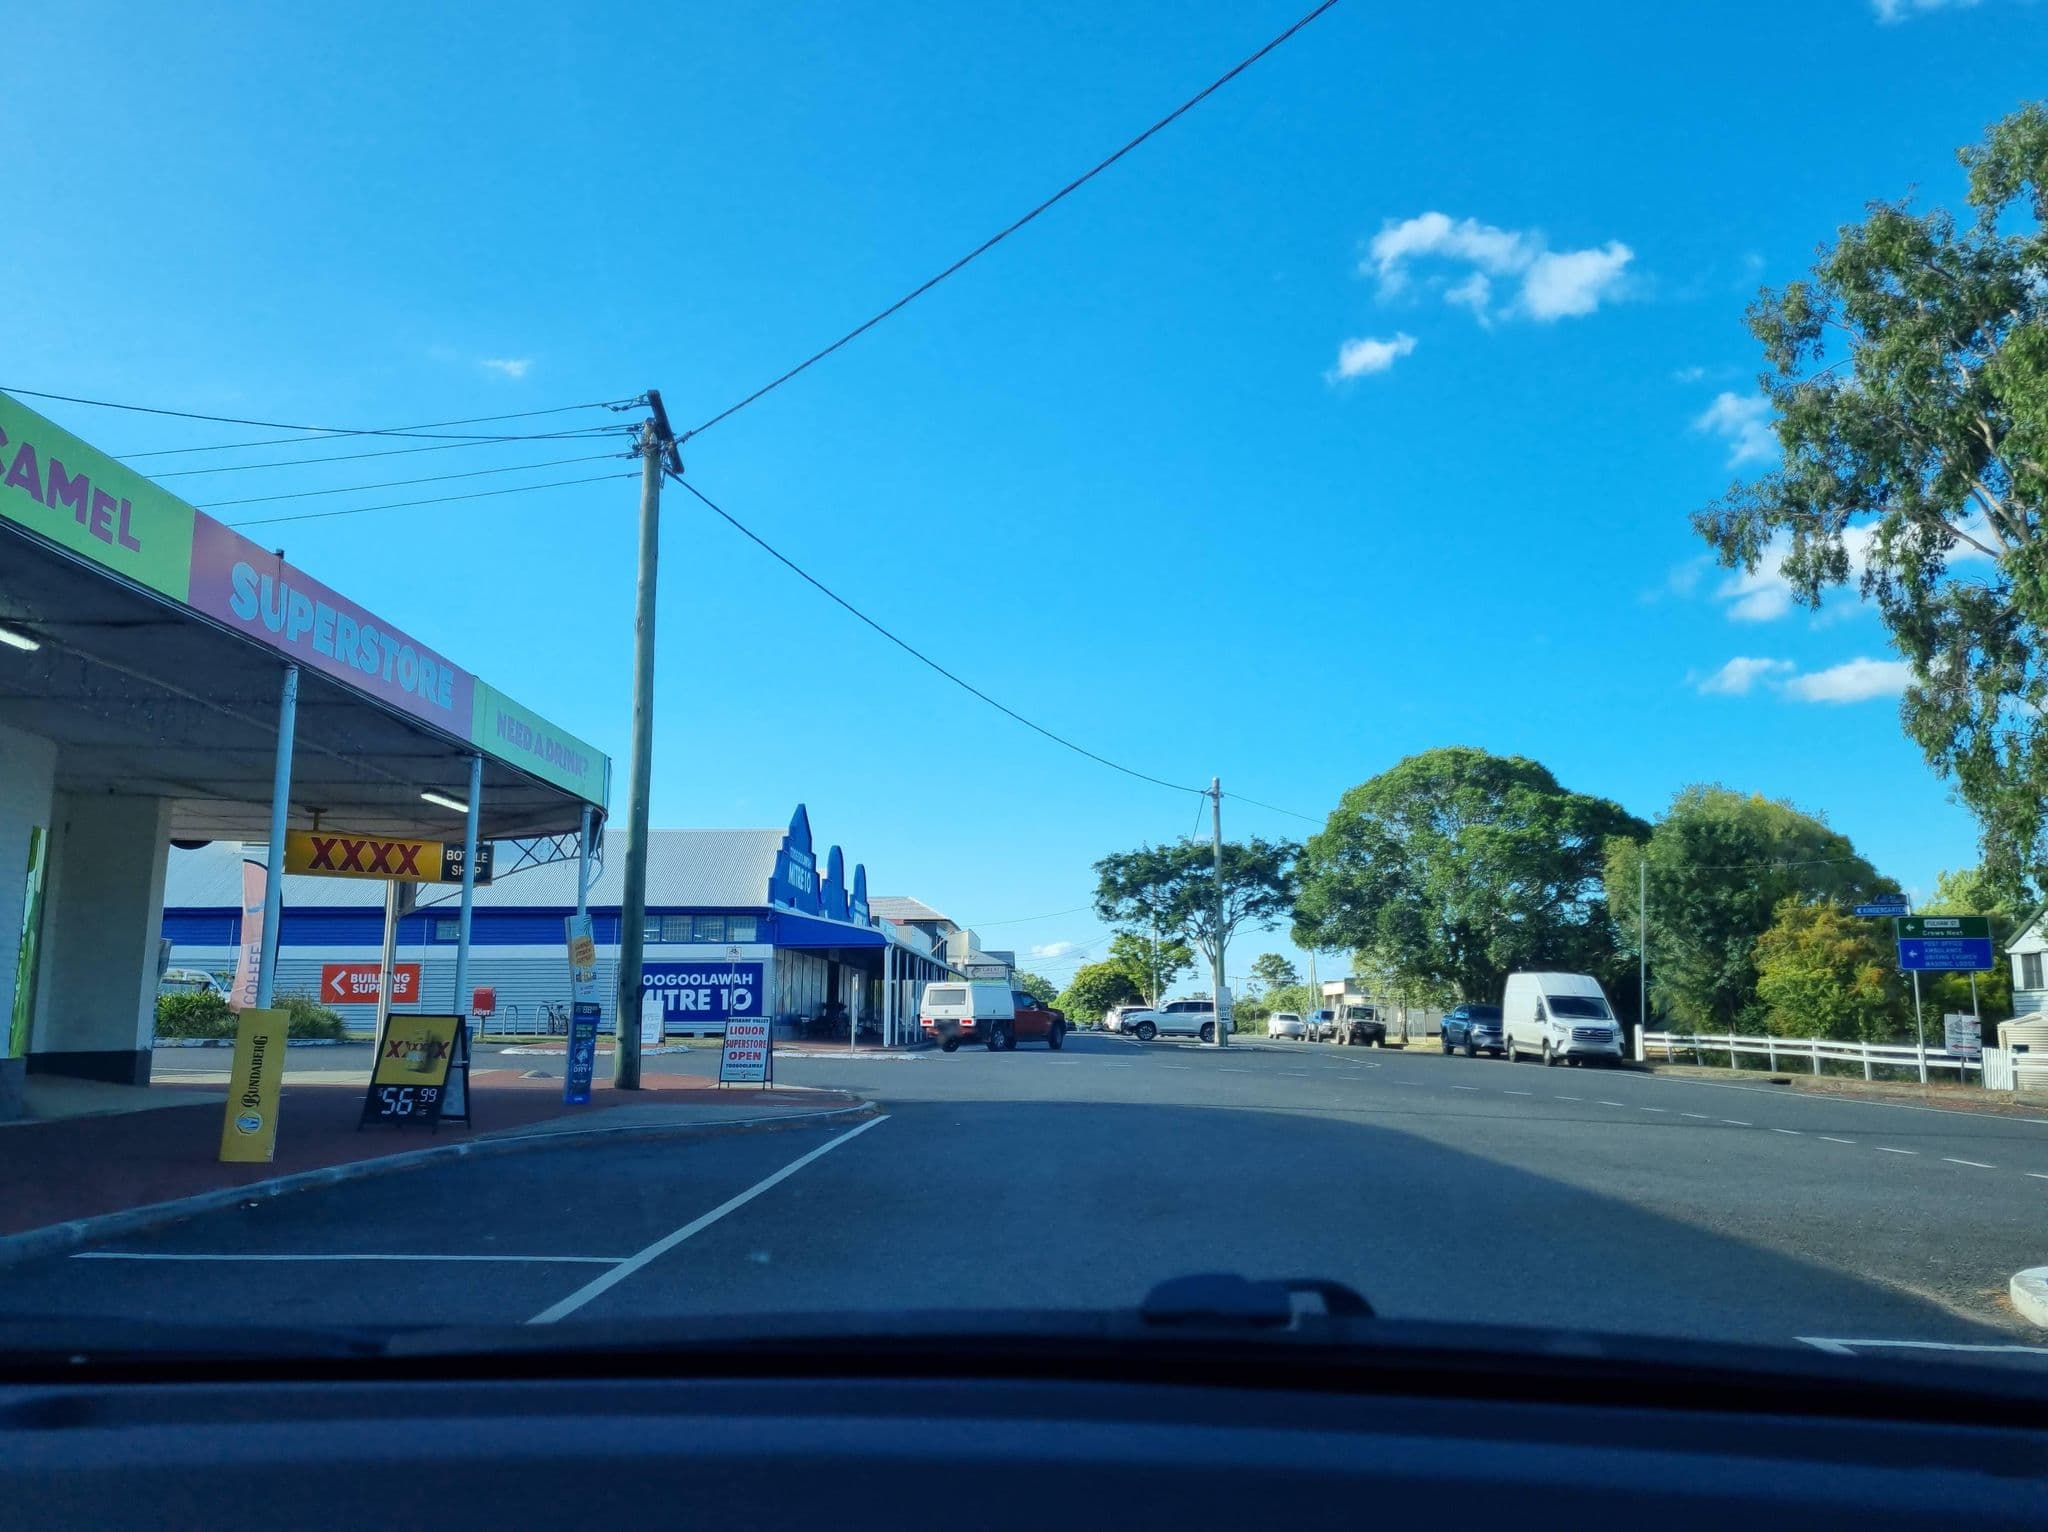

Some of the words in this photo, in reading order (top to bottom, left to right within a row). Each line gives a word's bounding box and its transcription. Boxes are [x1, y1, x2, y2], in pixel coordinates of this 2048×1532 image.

[0, 424, 141, 552] AMEL
[229, 561, 454, 711] SUPERSTORE
[496, 708, 532, 752] NEED
[534, 732, 545, 759] A
[546, 738, 589, 780] DRINK?
[308, 836, 422, 876] XXXX
[446, 849, 487, 863] BOLE
[451, 864, 481, 876] SHP
[350, 973, 410, 984] BUILNG
[642, 973, 752, 986] OOGOOLAWAH
[721, 988, 752, 1010] 10
[473, 1007, 491, 1016] POST
[730, 1026, 765, 1035] LIQUOR
[725, 1039, 767, 1049] SUPERSTORE
[728, 1051, 761, 1061] OPEN
[240, 1035, 268, 1108] BUNDABERG
